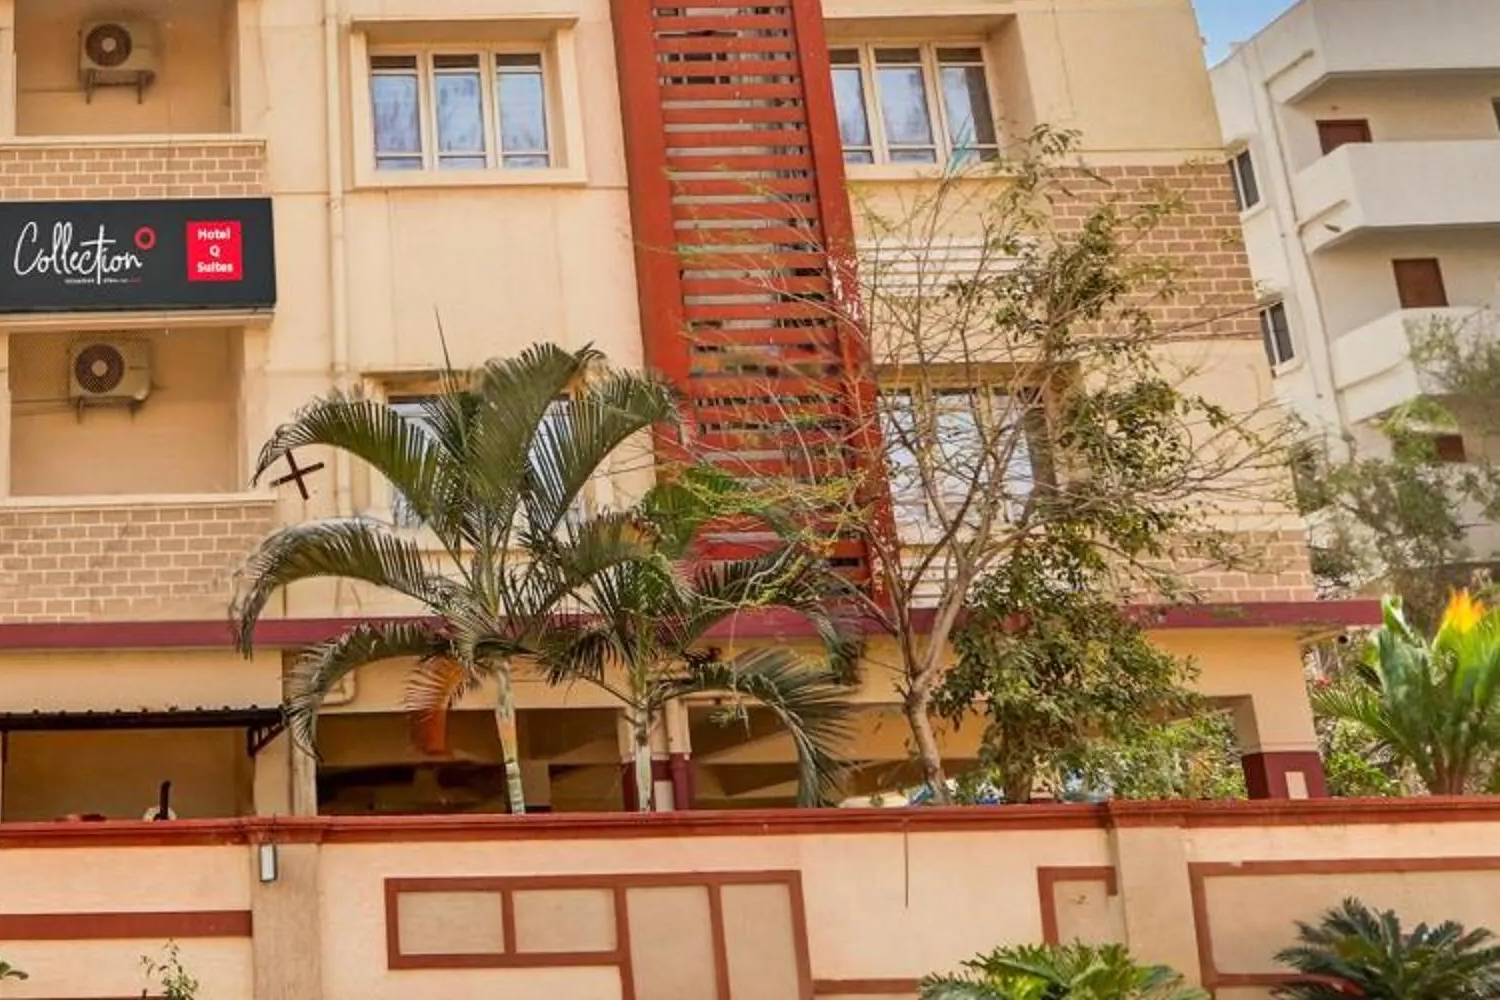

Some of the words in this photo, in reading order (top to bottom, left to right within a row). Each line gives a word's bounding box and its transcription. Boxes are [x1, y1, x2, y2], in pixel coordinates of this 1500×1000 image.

[197, 227, 231, 240] Hotel
[13, 221, 143, 285] Collection
[209, 245, 221, 258] Q
[197, 261, 234, 273] Suites
